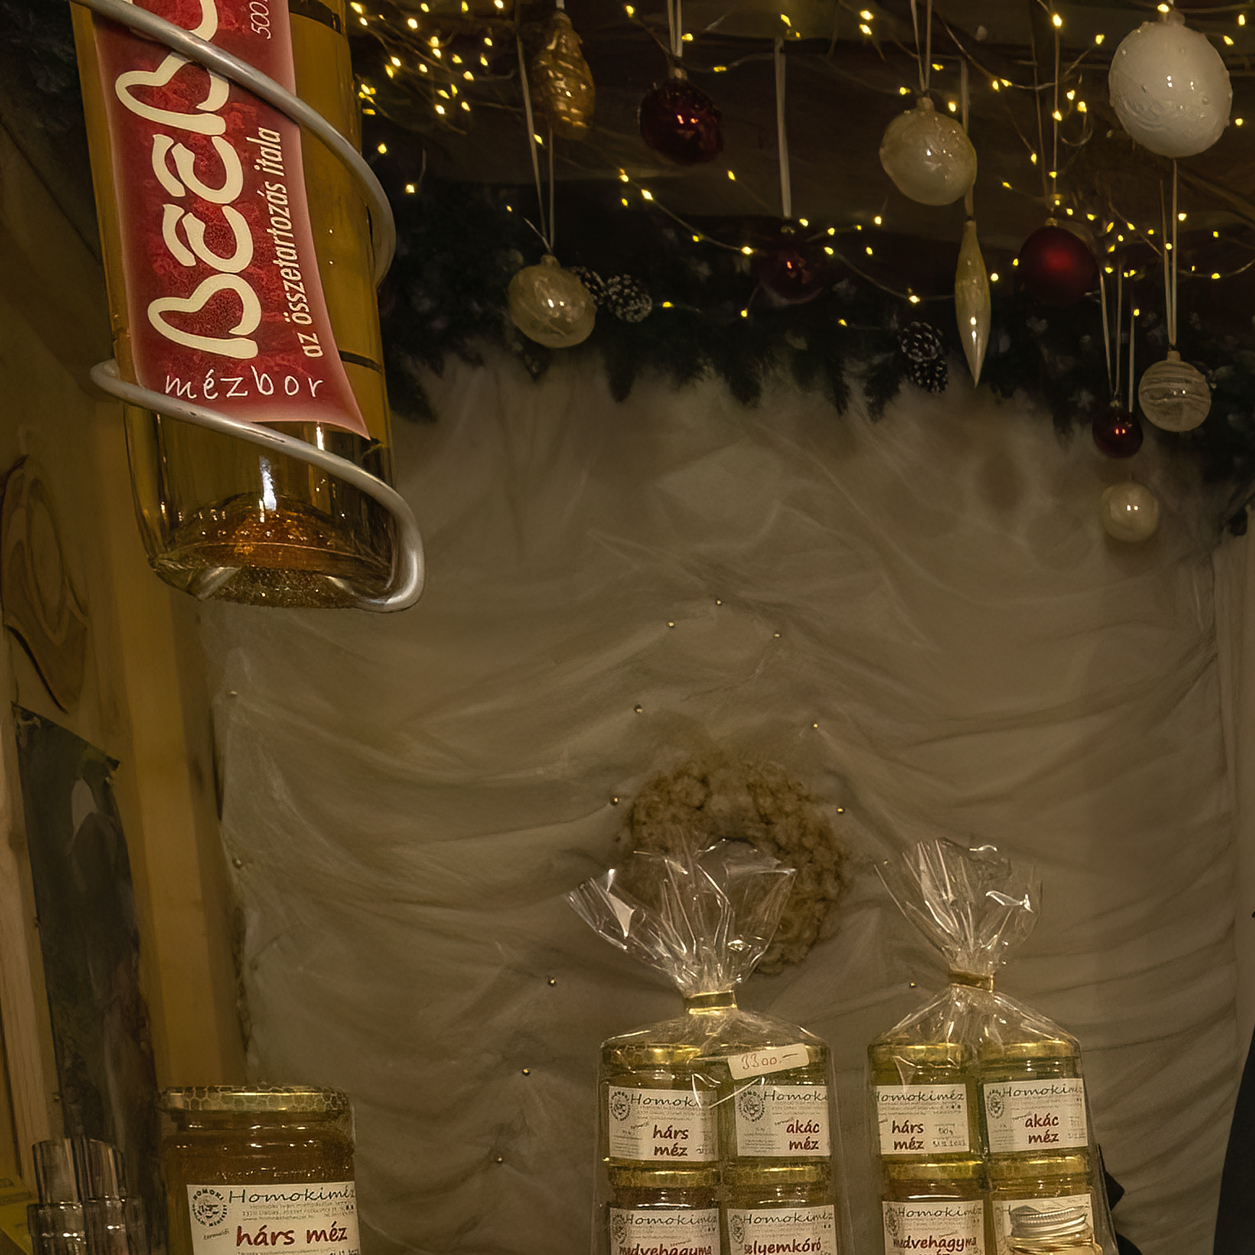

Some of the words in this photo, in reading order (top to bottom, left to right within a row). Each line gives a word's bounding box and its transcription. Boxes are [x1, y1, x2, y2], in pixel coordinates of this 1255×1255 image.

[251, 126, 283, 174] itala
[276, 179, 314, 327] összetartozás
[300, 331, 324, 358] az
[164, 368, 325, 401] mézbor
[786, 1118, 822, 1134] akác
[891, 1119, 925, 1135] hárs
[1024, 1113, 1060, 1129] akác
[653, 1124, 690, 1140] hárs
[1028, 1129, 1060, 1145] méz
[653, 1141, 689, 1157] méz
[788, 1136, 821, 1152] méz
[893, 1137, 926, 1151] méz
[236, 1224, 296, 1248] hárs
[306, 1222, 349, 1244] méz
